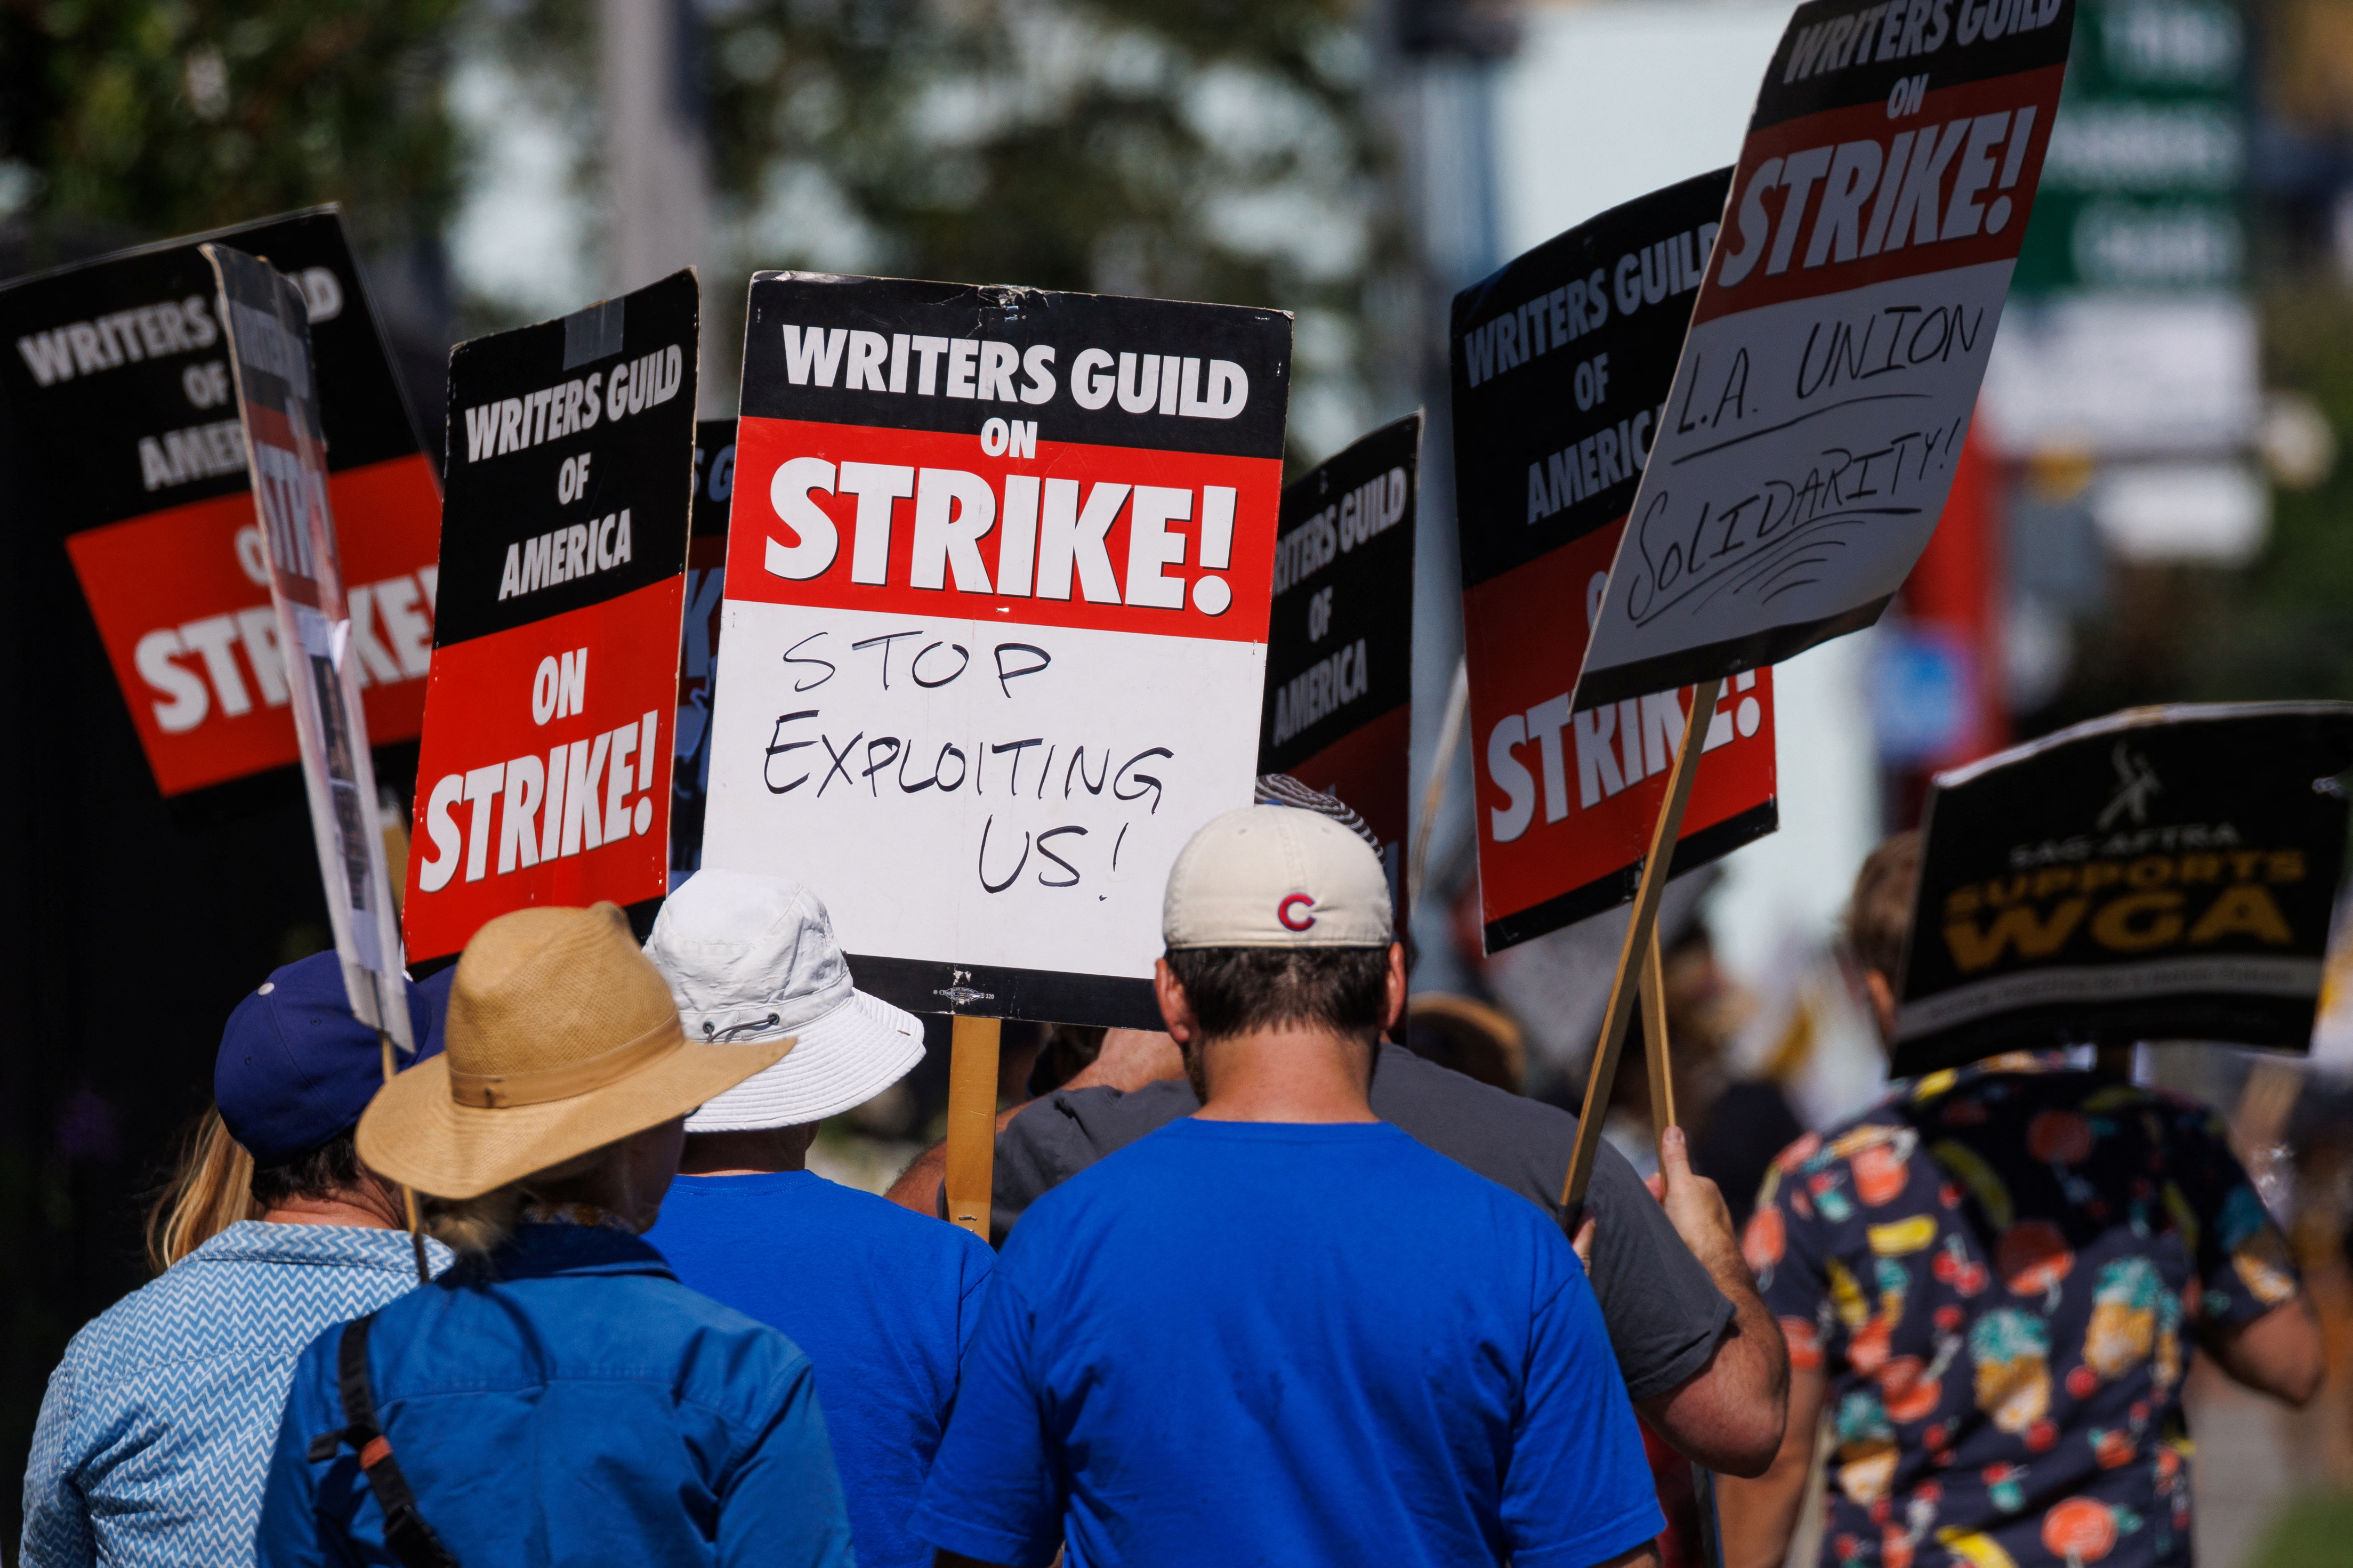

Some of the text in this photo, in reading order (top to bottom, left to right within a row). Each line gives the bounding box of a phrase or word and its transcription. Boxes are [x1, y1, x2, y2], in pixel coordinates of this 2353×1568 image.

[1783, 0, 1953, 85] WRITERS
[1887, 73, 1929, 119] ON
[1718, 106, 2037, 288] STRIKE!
[16, 295, 217, 388] WRITERS
[783, 324, 1249, 419] WRITERS GUILD
[1464, 268, 1609, 388] WRITERS
[1677, 304, 1983, 435] L.A. UNION
[182, 360, 228, 409] OF
[465, 344, 682, 463] WRITERS GUILD
[1574, 352, 1609, 411] OF
[138, 418, 249, 491] AMER
[558, 452, 592, 505] OF
[980, 417, 1037, 459] ON
[235, 525, 269, 586] O
[498, 510, 631, 601] AMERICA
[764, 457, 1237, 617] STRIKE!
[1272, 466, 1407, 597] RITERS GUILD
[133, 562, 438, 734] STRKE
[1309, 586, 1332, 642] OF
[532, 648, 587, 726] ON
[783, 631, 1051, 698] STOP
[1273, 638, 1368, 747] AMERICA
[419, 709, 658, 893] STRIKE!
[763, 709, 1174, 814] EXPLOITING
[978, 814, 1129, 901] US!
[1945, 848, 2309, 915] SUPPORTS
[1278, 893, 1316, 932] C
[1940, 882, 2296, 973] WGA
